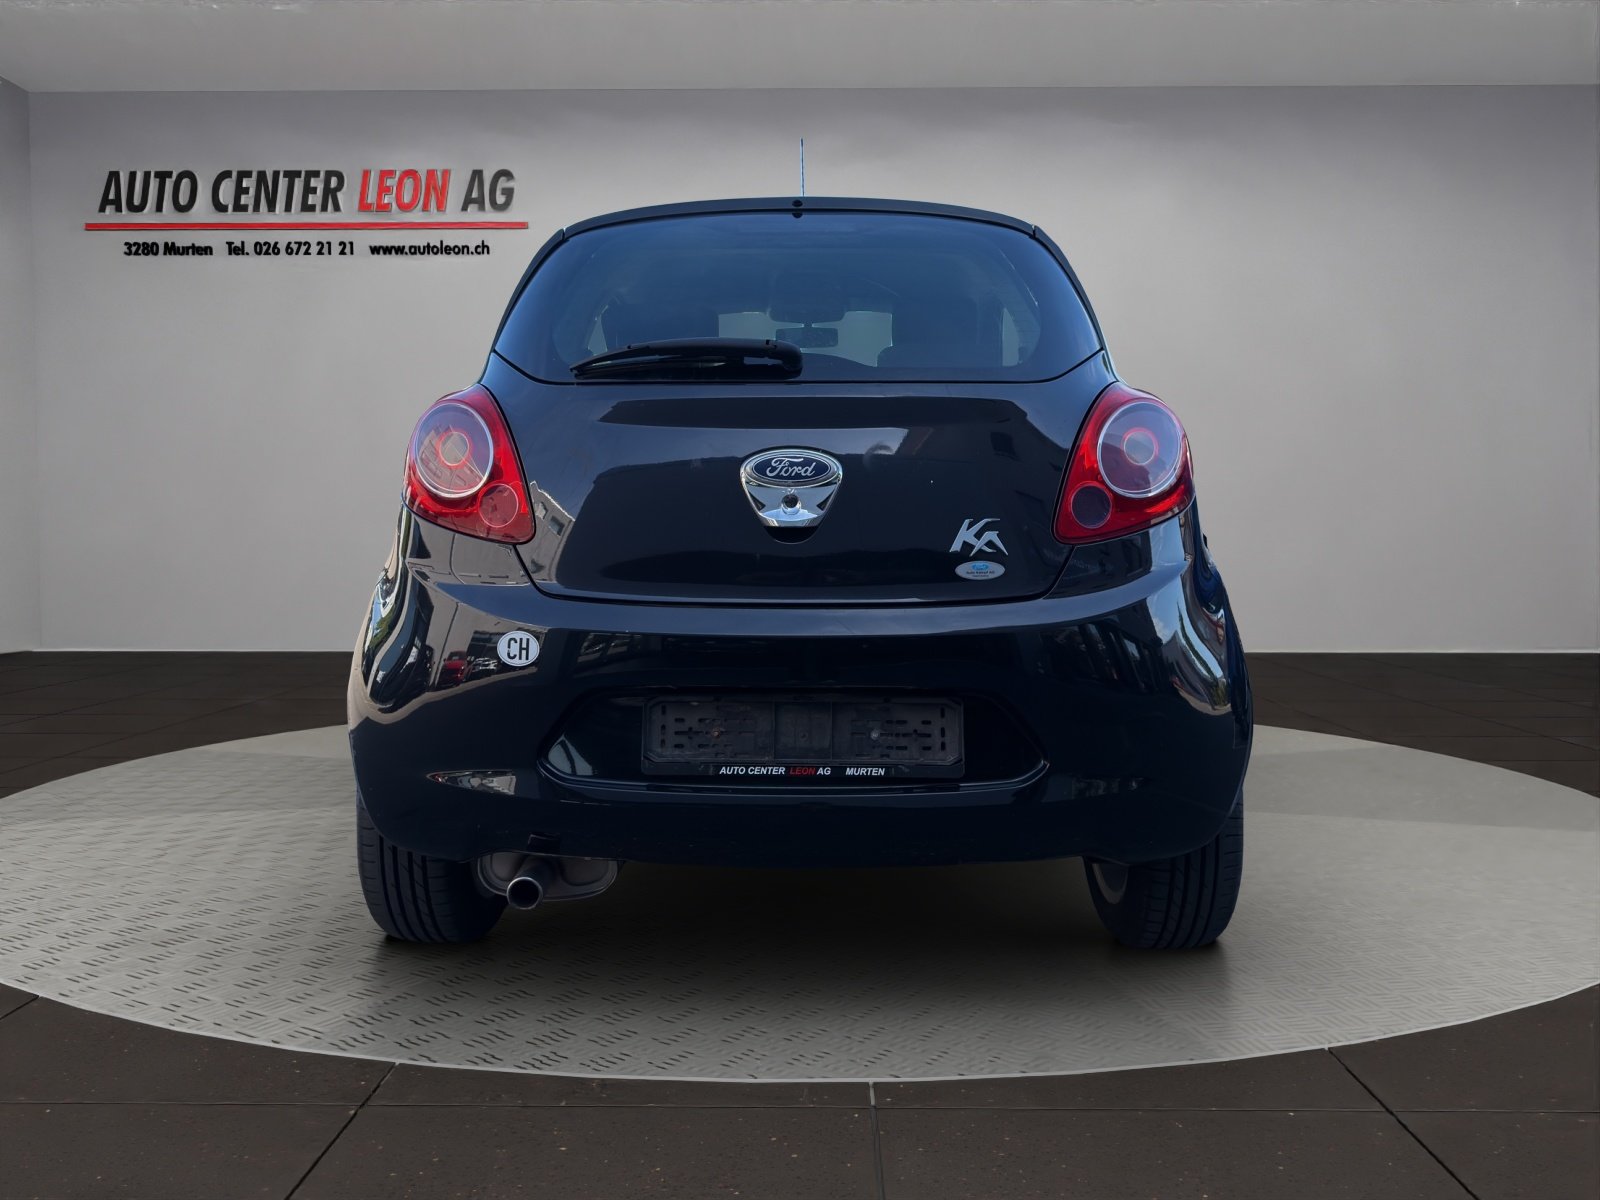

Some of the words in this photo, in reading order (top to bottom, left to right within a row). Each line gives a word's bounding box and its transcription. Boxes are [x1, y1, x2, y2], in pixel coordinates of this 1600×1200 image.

[98, 170, 198, 213] AUTO
[211, 169, 345, 213] CENTER
[358, 168, 451, 212] LEON
[460, 168, 515, 212] AG
[124, 241, 160, 256] 3280
[163, 241, 213, 256] Murten
[226, 240, 250, 256] Tel.
[254, 241, 281, 256] 026
[285, 241, 312, 256] 672
[316, 241, 332, 256] 21
[338, 241, 354, 256] 21
[369, 239, 490, 256] www.autoleon.ch
[765, 457, 817, 477] Ford
[506, 637, 530, 661] CH
[719, 766, 746, 775] AUTO
[747, 766, 786, 775] CENTER
[789, 767, 816, 776] LEON
[816, 767, 831, 776] AG
[845, 767, 886, 776] MURTEN
